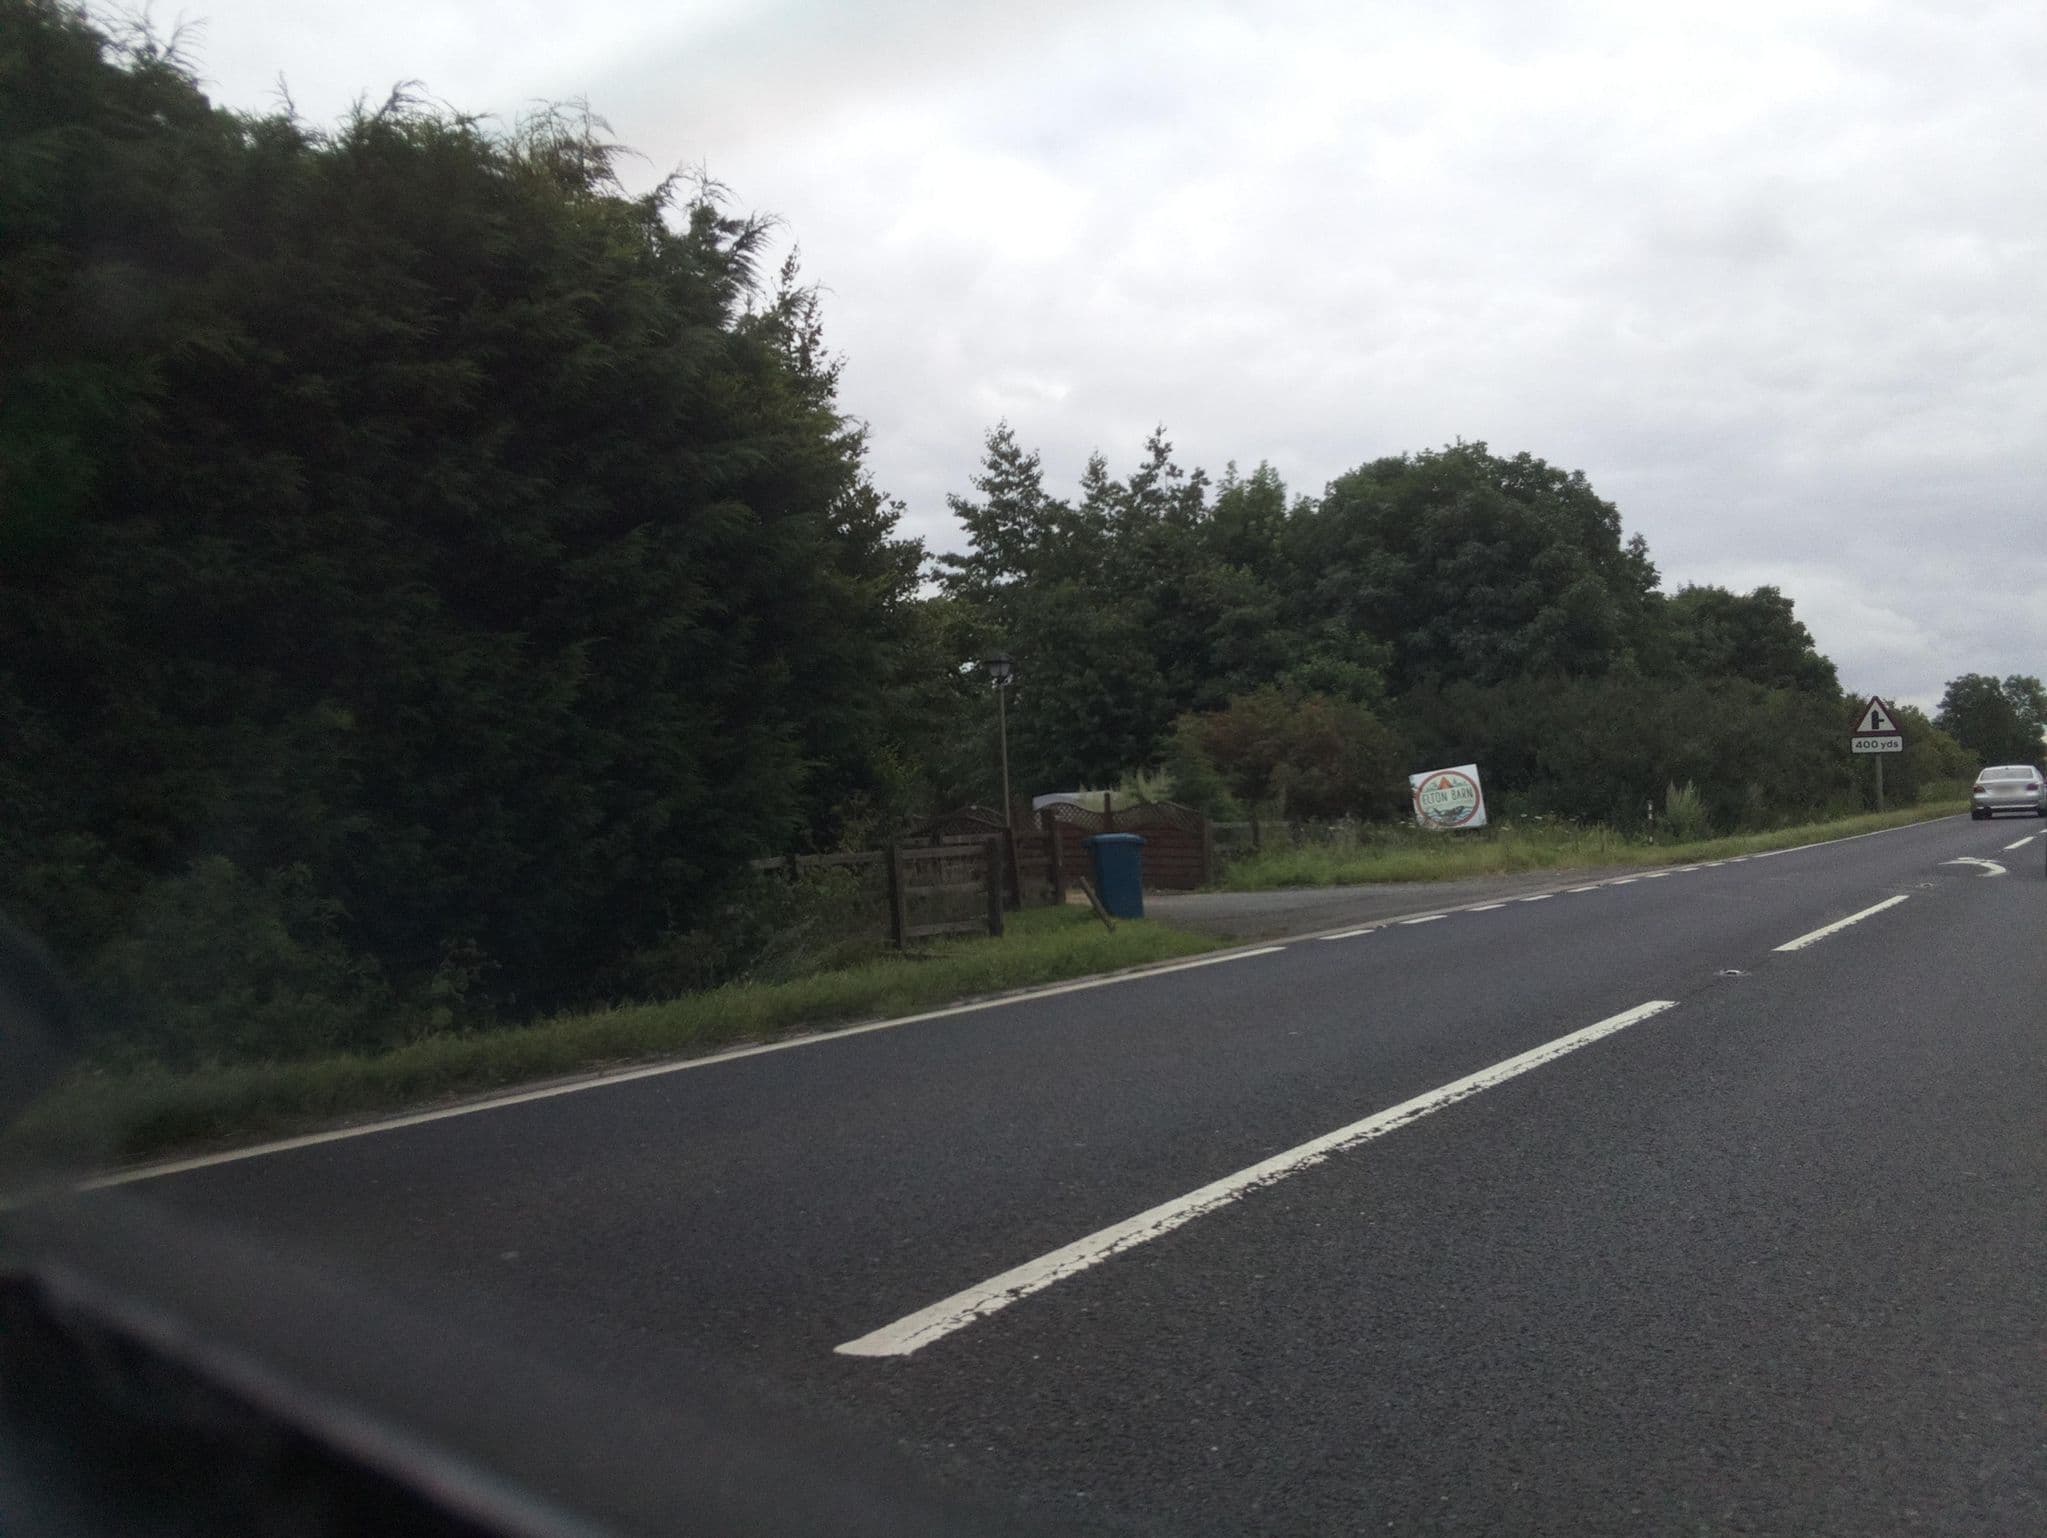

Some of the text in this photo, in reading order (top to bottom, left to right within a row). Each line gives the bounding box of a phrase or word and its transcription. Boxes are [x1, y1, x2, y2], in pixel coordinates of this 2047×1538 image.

[1855, 739, 1899, 750] 400 yds
[1450, 786, 1474, 800] BARN
